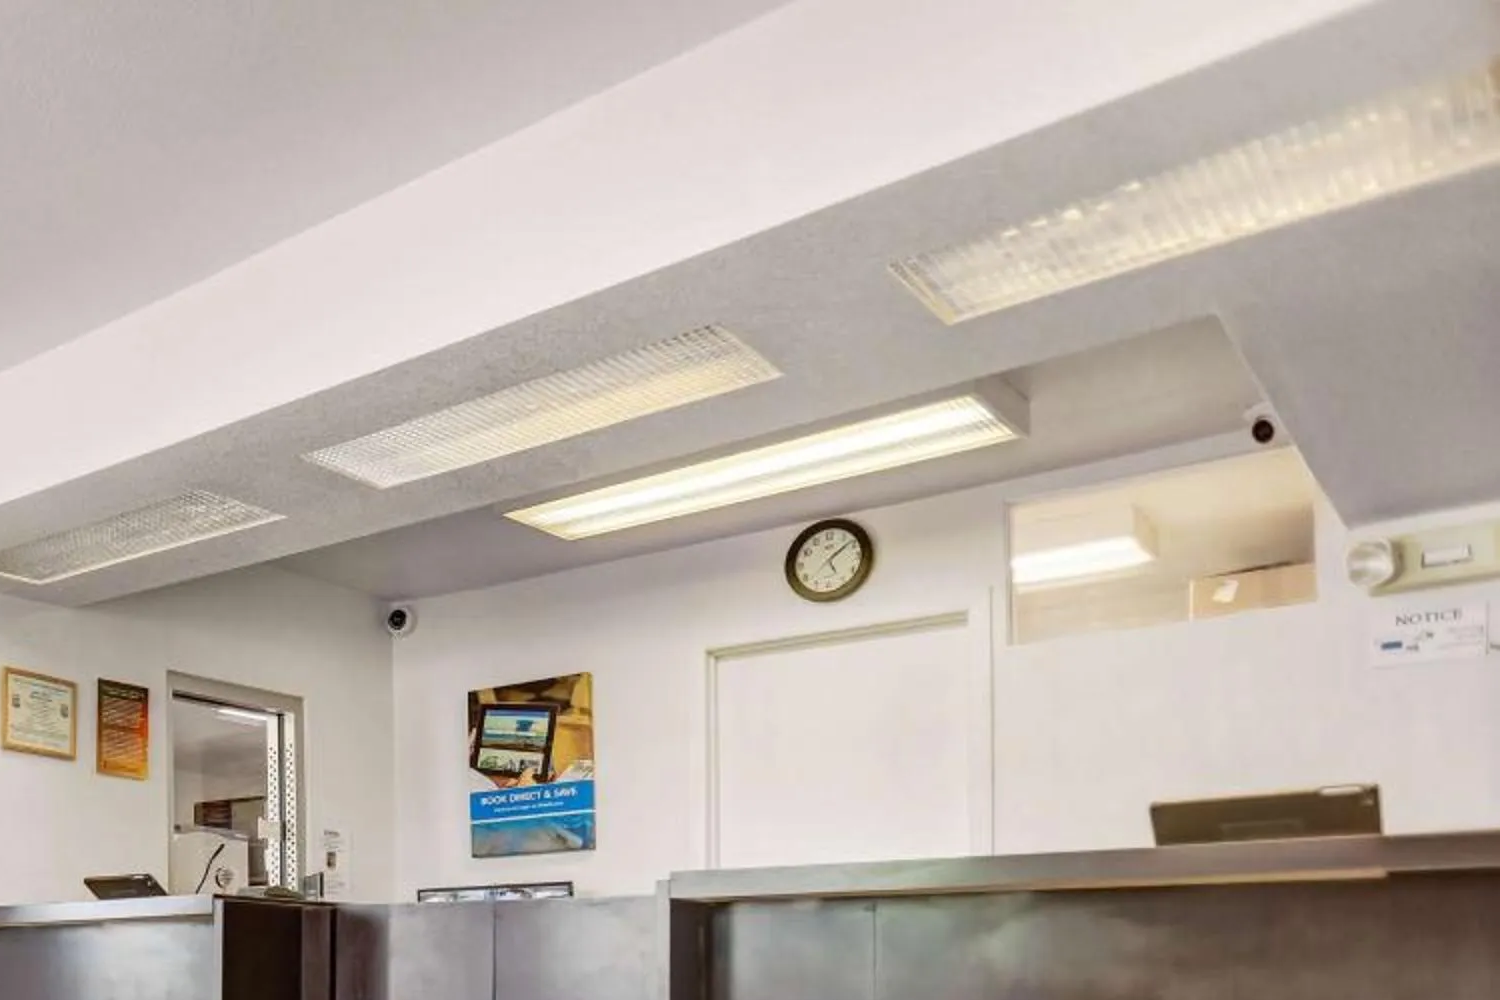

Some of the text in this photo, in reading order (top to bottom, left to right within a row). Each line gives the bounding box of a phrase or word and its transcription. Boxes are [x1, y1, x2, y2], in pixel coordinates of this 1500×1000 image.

[1395, 608, 1463, 626] NOTICE
[482, 794, 508, 806] BOOK
[509, 789, 541, 803] DIRECT
[543, 789, 551, 799] &
